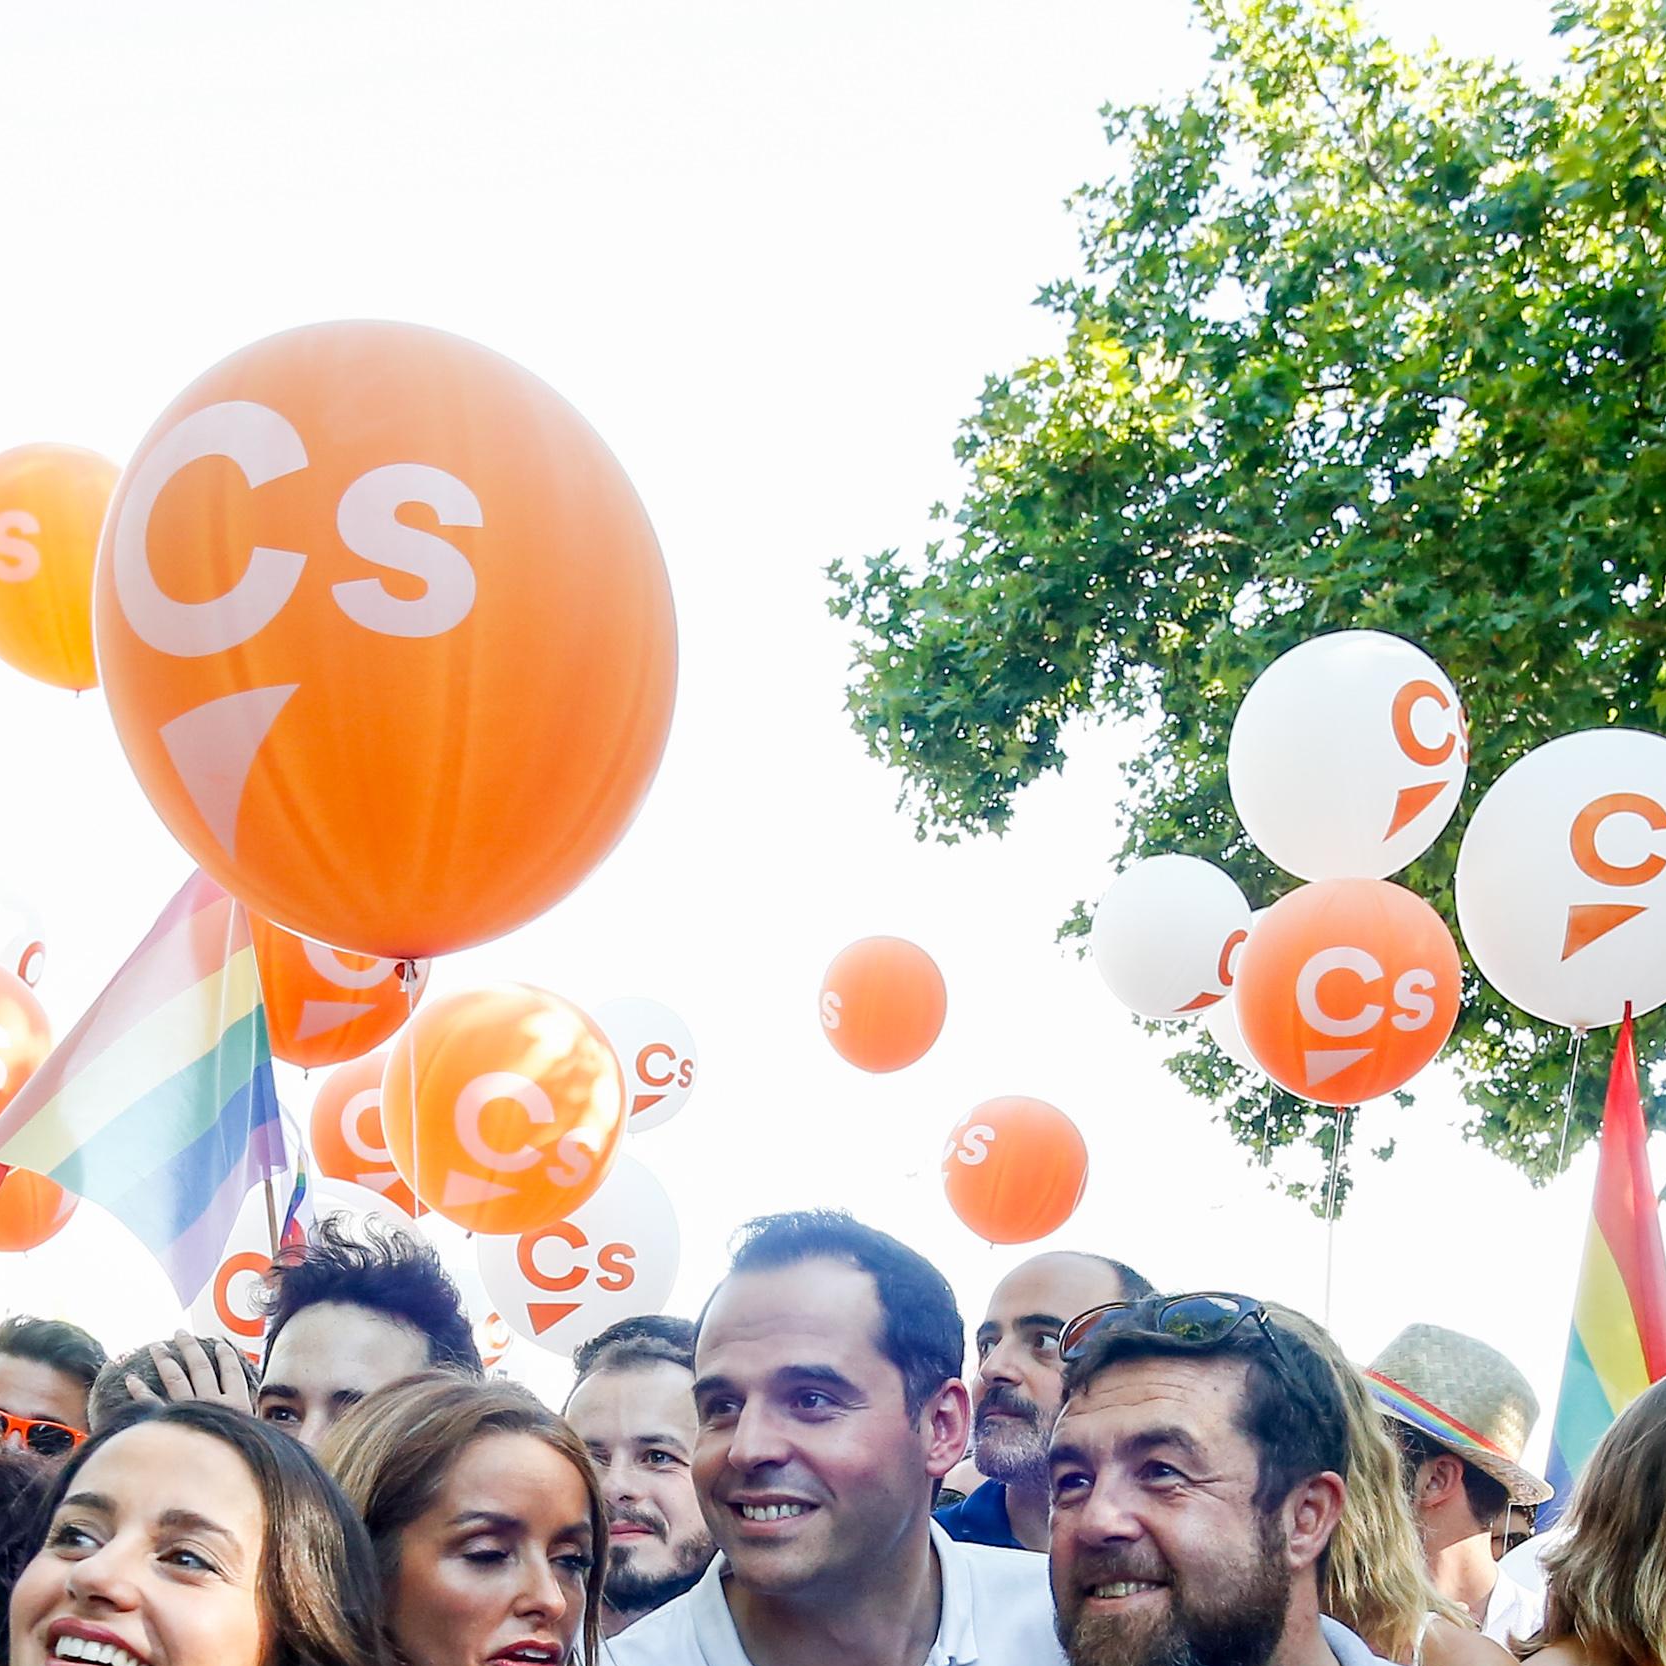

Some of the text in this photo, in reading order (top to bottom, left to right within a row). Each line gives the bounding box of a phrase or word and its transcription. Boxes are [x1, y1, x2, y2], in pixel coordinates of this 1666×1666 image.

[115, 400, 484, 658] Cs
[1295, 946, 1436, 1038] Cs
[636, 1042, 694, 1089] Cs
[454, 1071, 594, 1188] Cs
[517, 1220, 637, 1293] Cs
